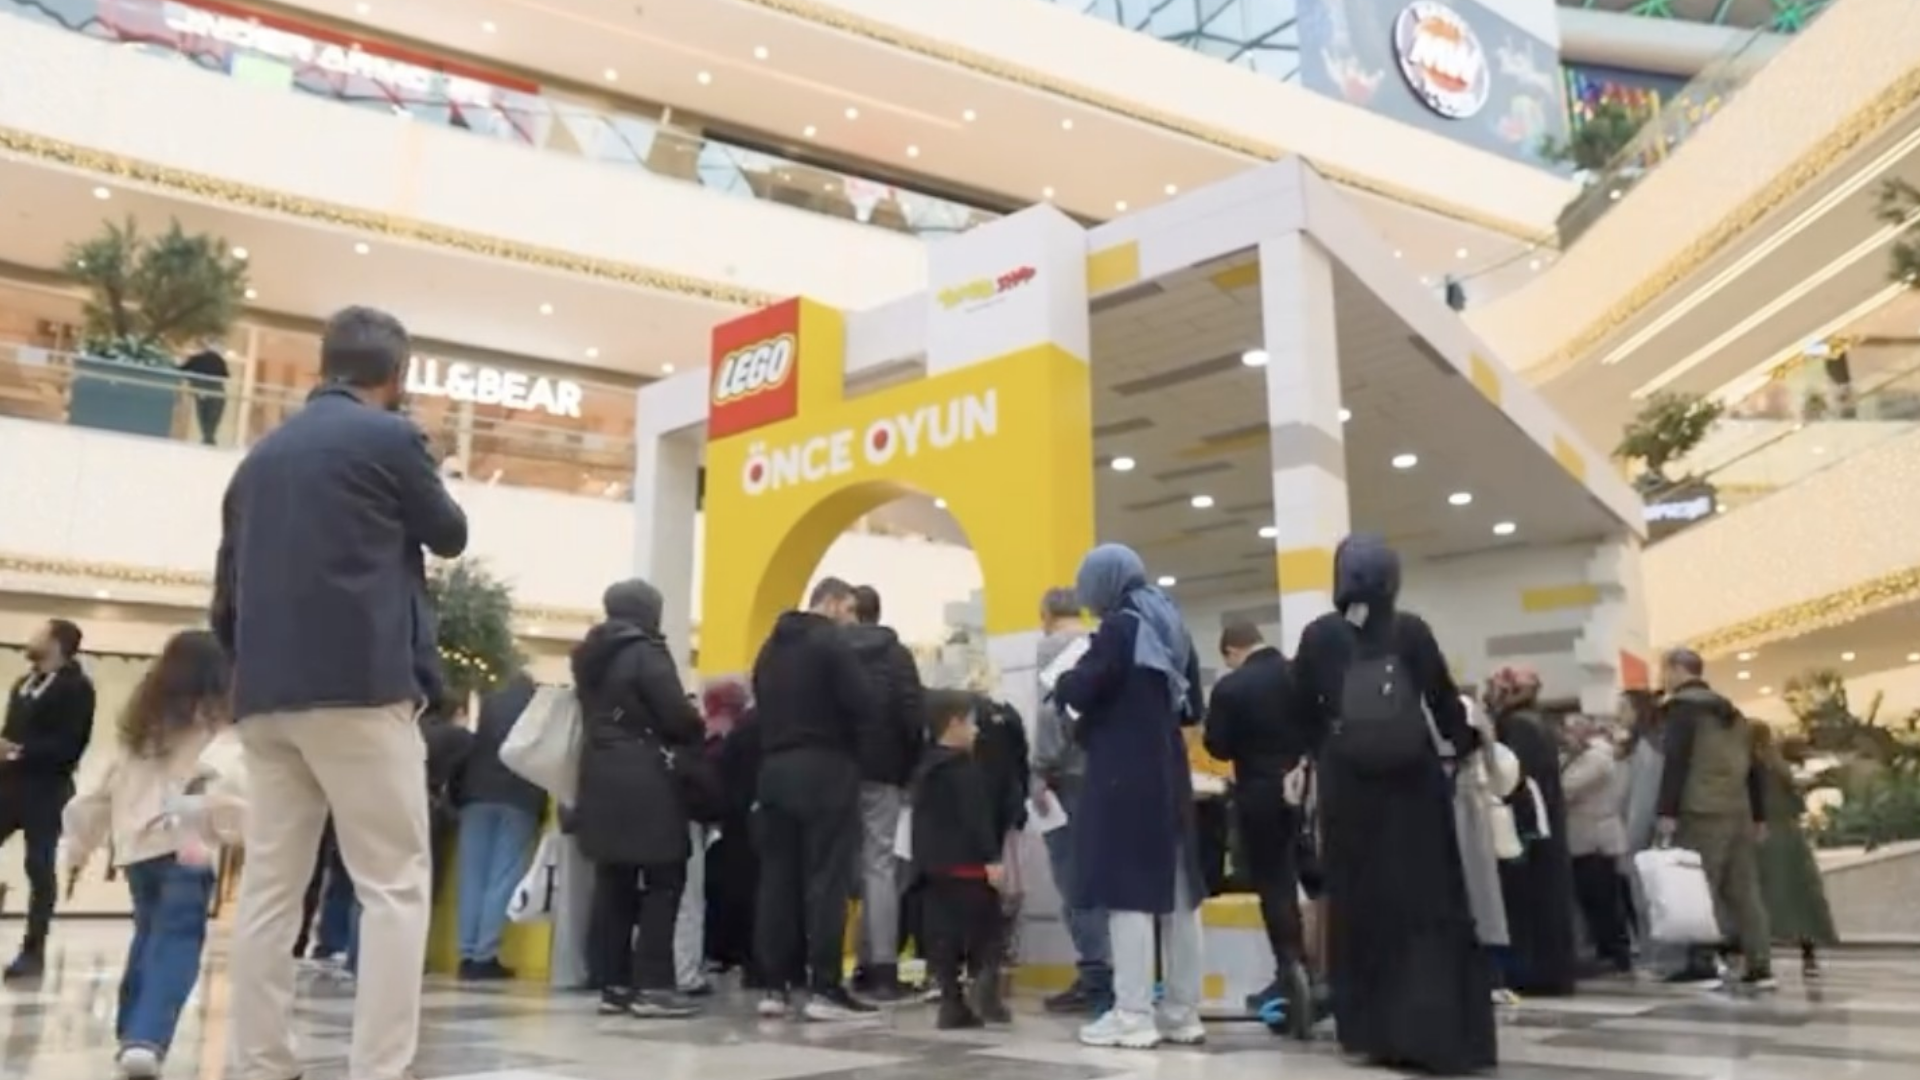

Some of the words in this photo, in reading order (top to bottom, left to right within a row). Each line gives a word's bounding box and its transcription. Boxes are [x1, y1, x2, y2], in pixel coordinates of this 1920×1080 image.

[405, 355, 583, 419] LL&BEAR
[715, 336, 794, 402] LEGO
[742, 427, 854, 495] ÖNCE
[864, 387, 998, 465] OYUN
